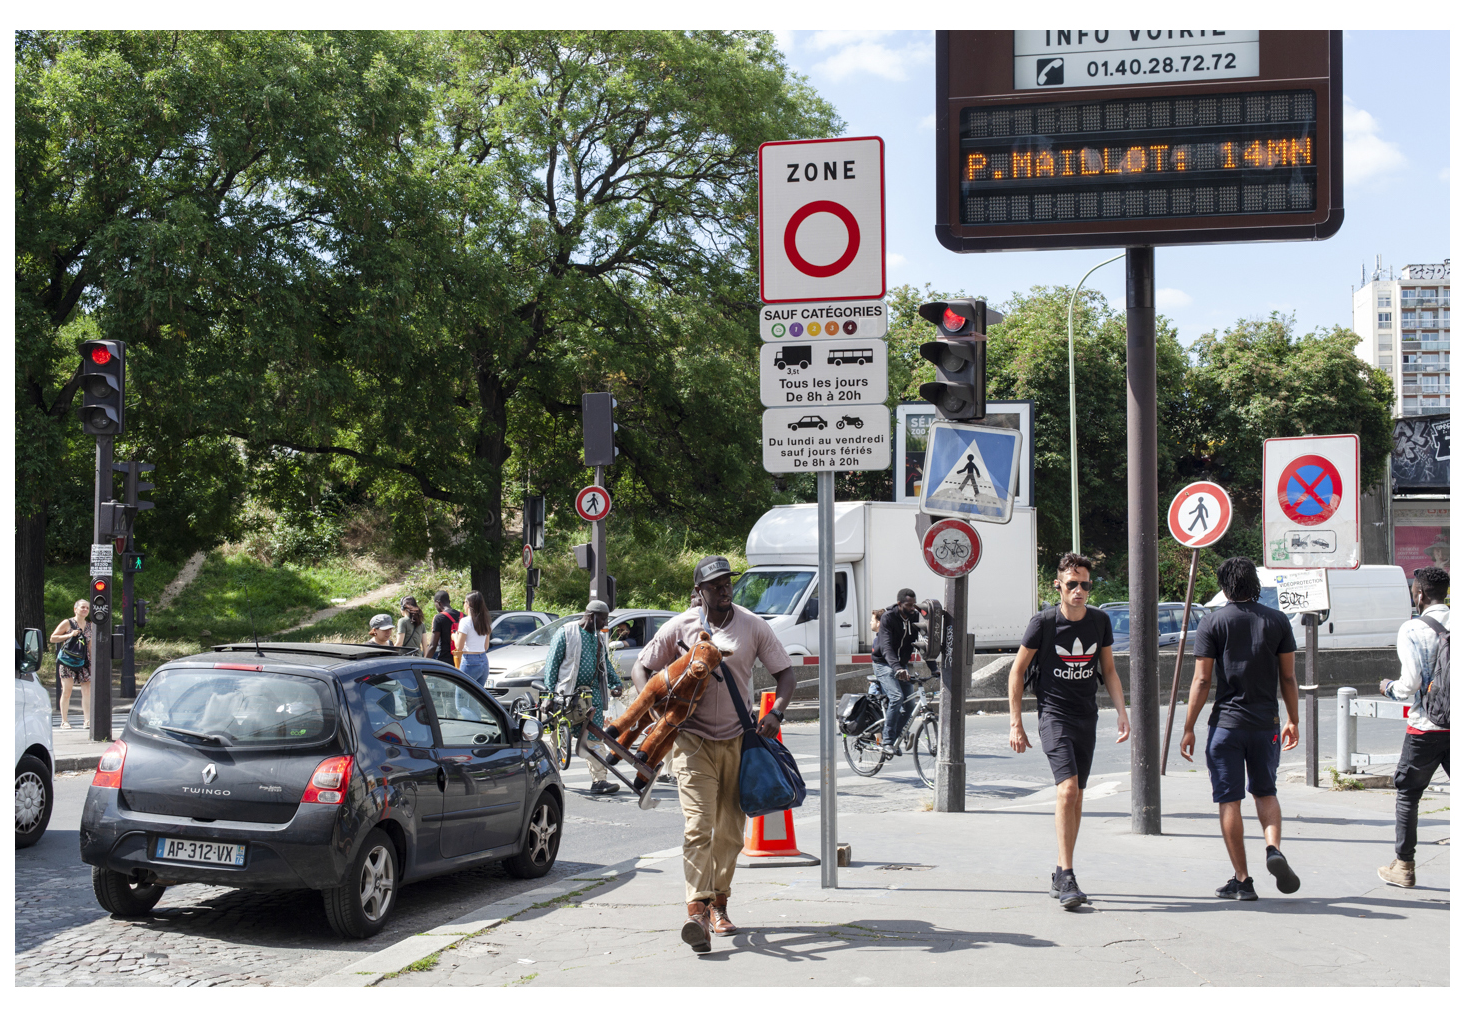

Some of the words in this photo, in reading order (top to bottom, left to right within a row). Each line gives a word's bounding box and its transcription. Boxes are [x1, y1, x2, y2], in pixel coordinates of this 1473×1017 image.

[1086, 53, 1237, 77] 01.40.28.72.72
[967, 144, 1186, 180] P.MAILLOT:
[786, 160, 856, 183] ZONE
[764, 309, 798, 321] SAUF
[801, 305, 882, 319] CATÉGORIES
[787, 367, 799, 375] 3,5t
[779, 378, 808, 389] Tous
[813, 378, 831, 388] les
[835, 377, 868, 389] jours
[786, 392, 803, 402] De
[807, 391, 822, 401] 8h
[826, 391, 834, 401] à
[838, 390, 861, 401] 20h
[769, 438, 783, 446] Du
[787, 437, 814, 446] lundi
[835, 435, 884, 444] vendredi
[781, 448, 804, 457] sauf
[808, 448, 836, 457] jours
[840, 447, 872, 455] fériés
[794, 459, 808, 467] De
[812, 458, 825, 467] 8h
[829, 458, 835, 467] à
[839, 458, 859, 466] 20h
[1279, 578, 1323, 587] VIDEOPROTECTION
[1053, 667, 1095, 680] adidas
[182, 786, 231, 796] TWINGO
[167, 840, 234, 862] AP-312-VX
